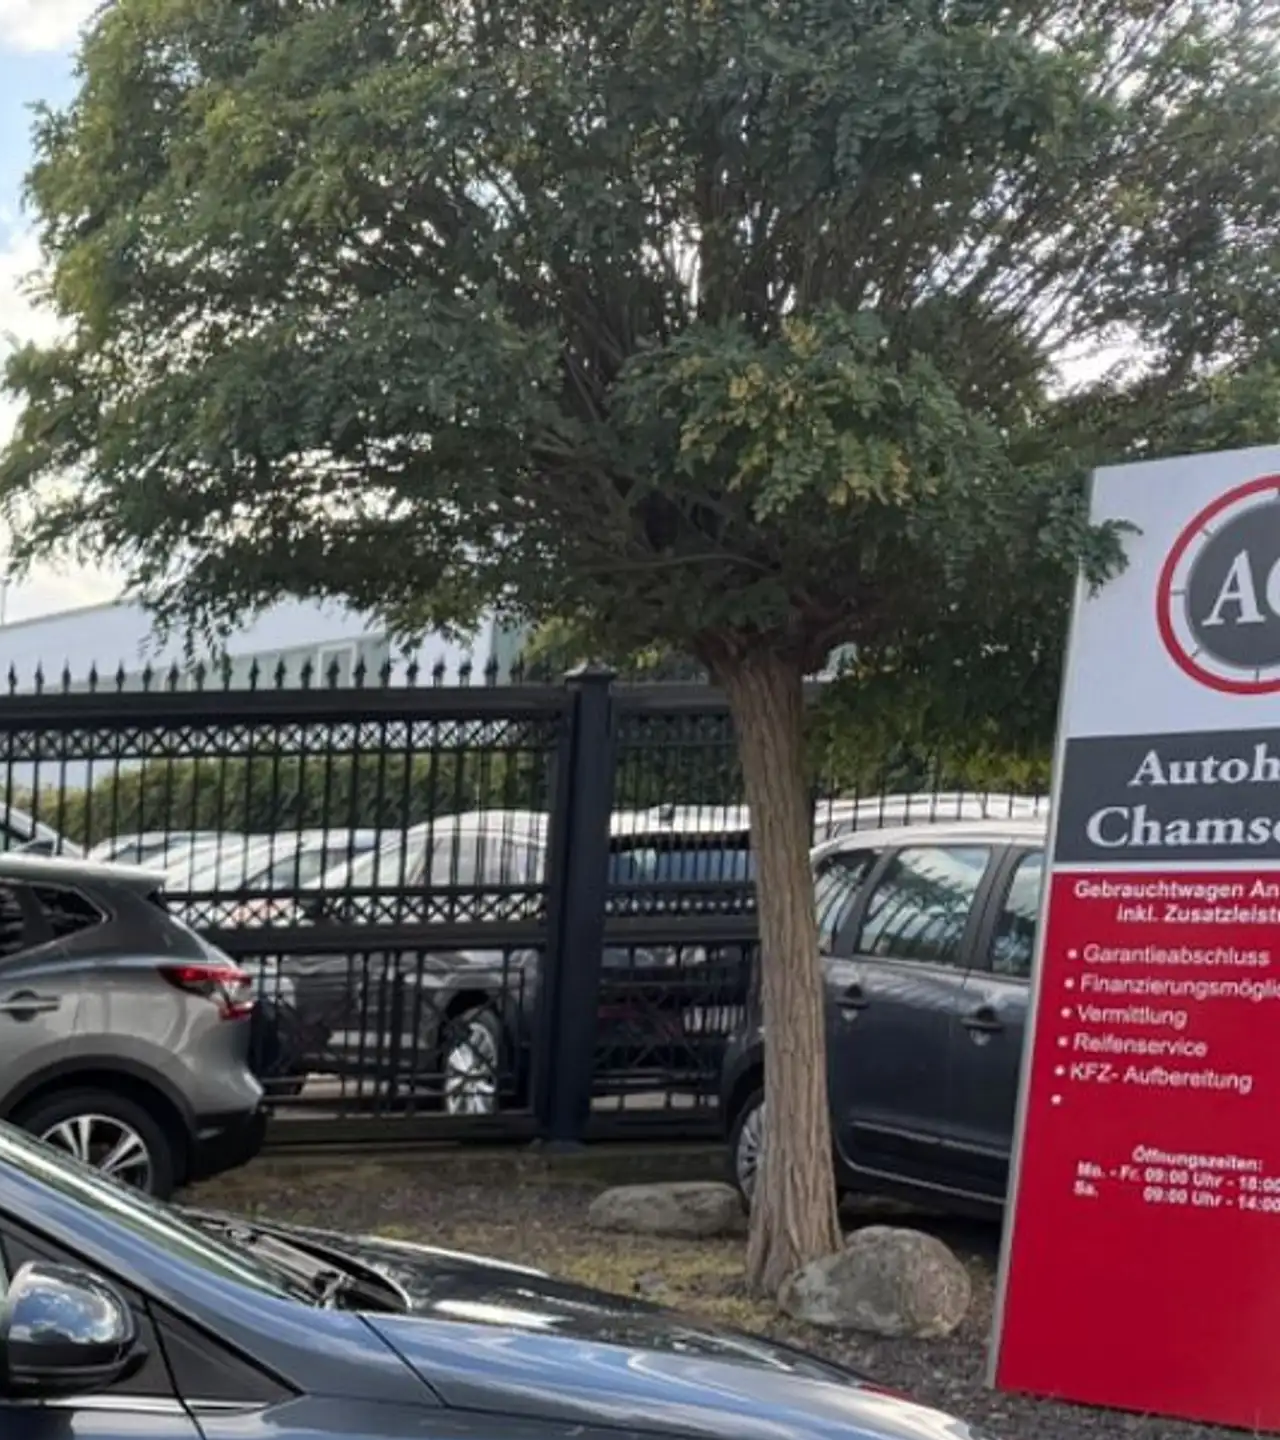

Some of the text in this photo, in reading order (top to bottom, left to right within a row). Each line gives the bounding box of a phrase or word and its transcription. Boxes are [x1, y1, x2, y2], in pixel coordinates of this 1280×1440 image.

[1201, 549, 1280, 627] A
[1127, 742, 1280, 787] Autoh
[1086, 804, 1280, 847] Chams
[1074, 879, 1244, 903] Gebrauchtwagen
[1163, 902, 1280, 924] Zusatzleist
[1083, 943, 1270, 966] Garantieabschluss
[1077, 1004, 1187, 1029] Vermittlung
[1073, 1032, 1208, 1057] Reifenservice
[1070, 1063, 1252, 1094] KFZ- Aufbereitung
[1193, 1171, 1224, 1189] Uhr
[1192, 1190, 1222, 1208] Uhr
